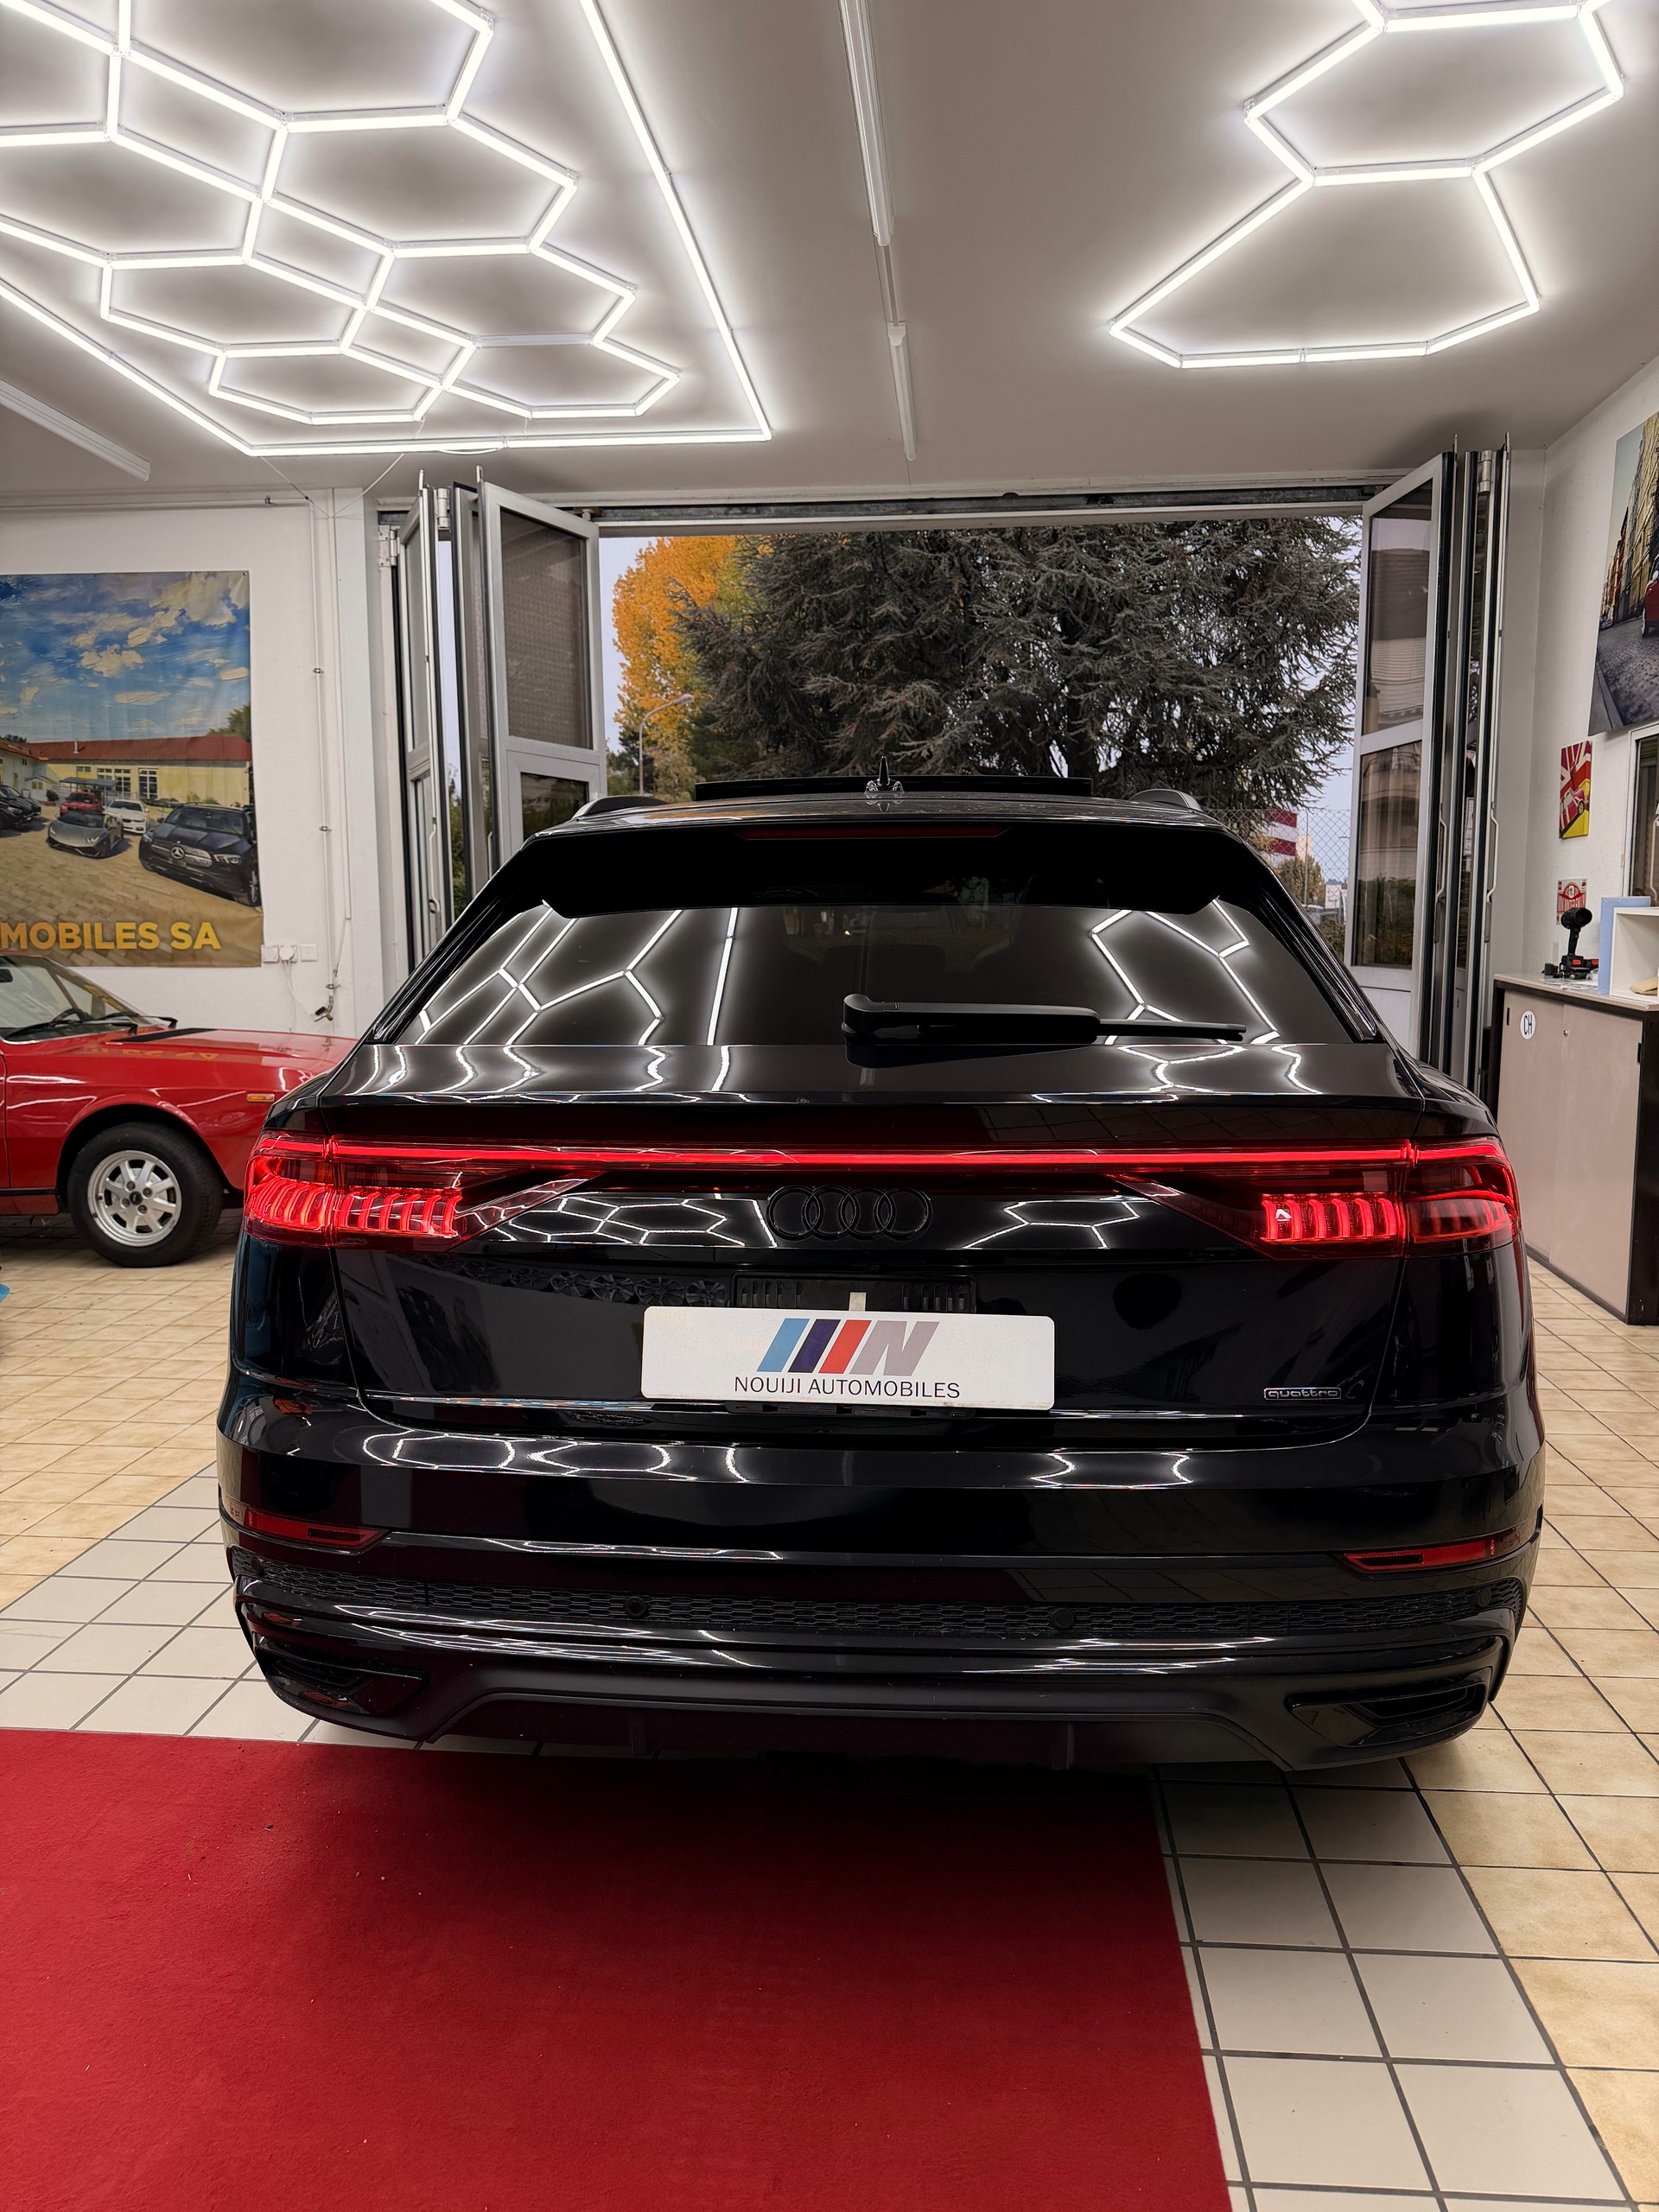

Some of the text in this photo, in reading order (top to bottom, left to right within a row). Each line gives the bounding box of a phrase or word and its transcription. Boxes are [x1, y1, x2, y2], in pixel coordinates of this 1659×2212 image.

[1, 922, 221, 950] MOBILES SA
[1523, 1014, 1533, 1035] CH
[734, 1376, 960, 1399] NOUIJI AUTOMOBILES
[1268, 1389, 1338, 1398] quattro
